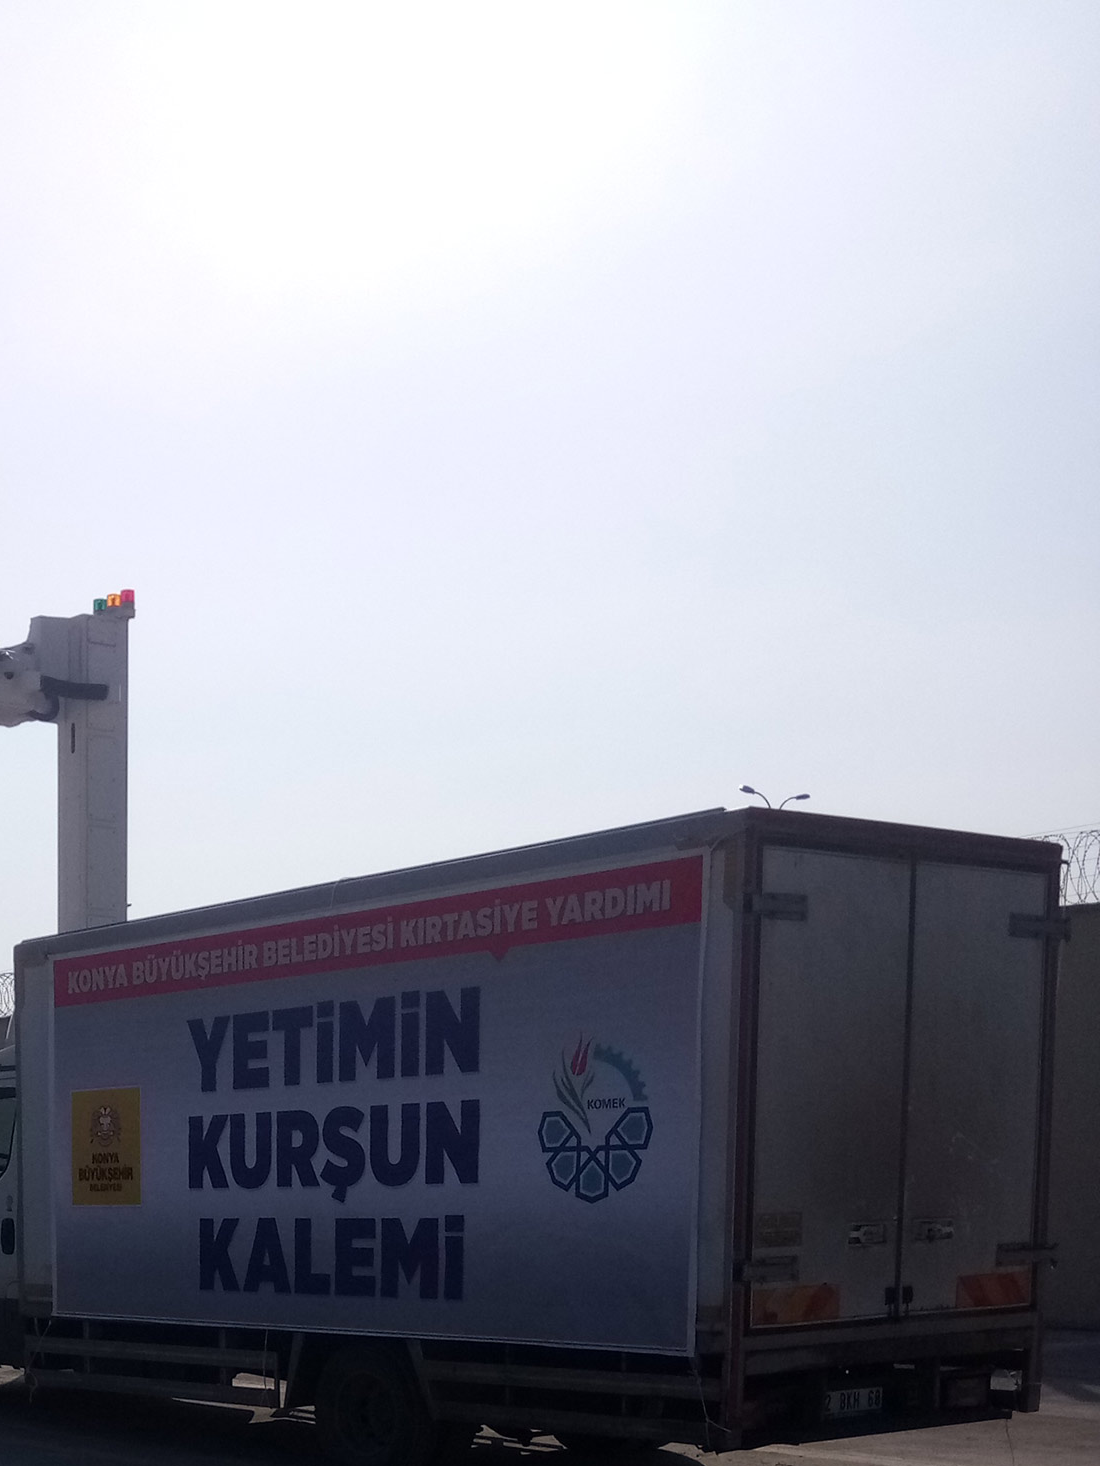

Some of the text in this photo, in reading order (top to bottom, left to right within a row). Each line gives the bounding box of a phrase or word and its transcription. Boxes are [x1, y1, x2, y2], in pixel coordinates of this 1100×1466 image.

[67, 879, 672, 994] KONYA BÜYÜKŞEHİR BELEDİYESİ KIRTASİYE YARDIMI
[186, 986, 482, 1093] YETİMİN
[587, 1097, 626, 1110] KOMEK
[78, 1165, 134, 1182] BÜYÜKŞEHİR
[91, 1152, 120, 1165] KONYA
[188, 1099, 481, 1203] KURŞUN
[199, 1214, 465, 1301] KALEMİ
